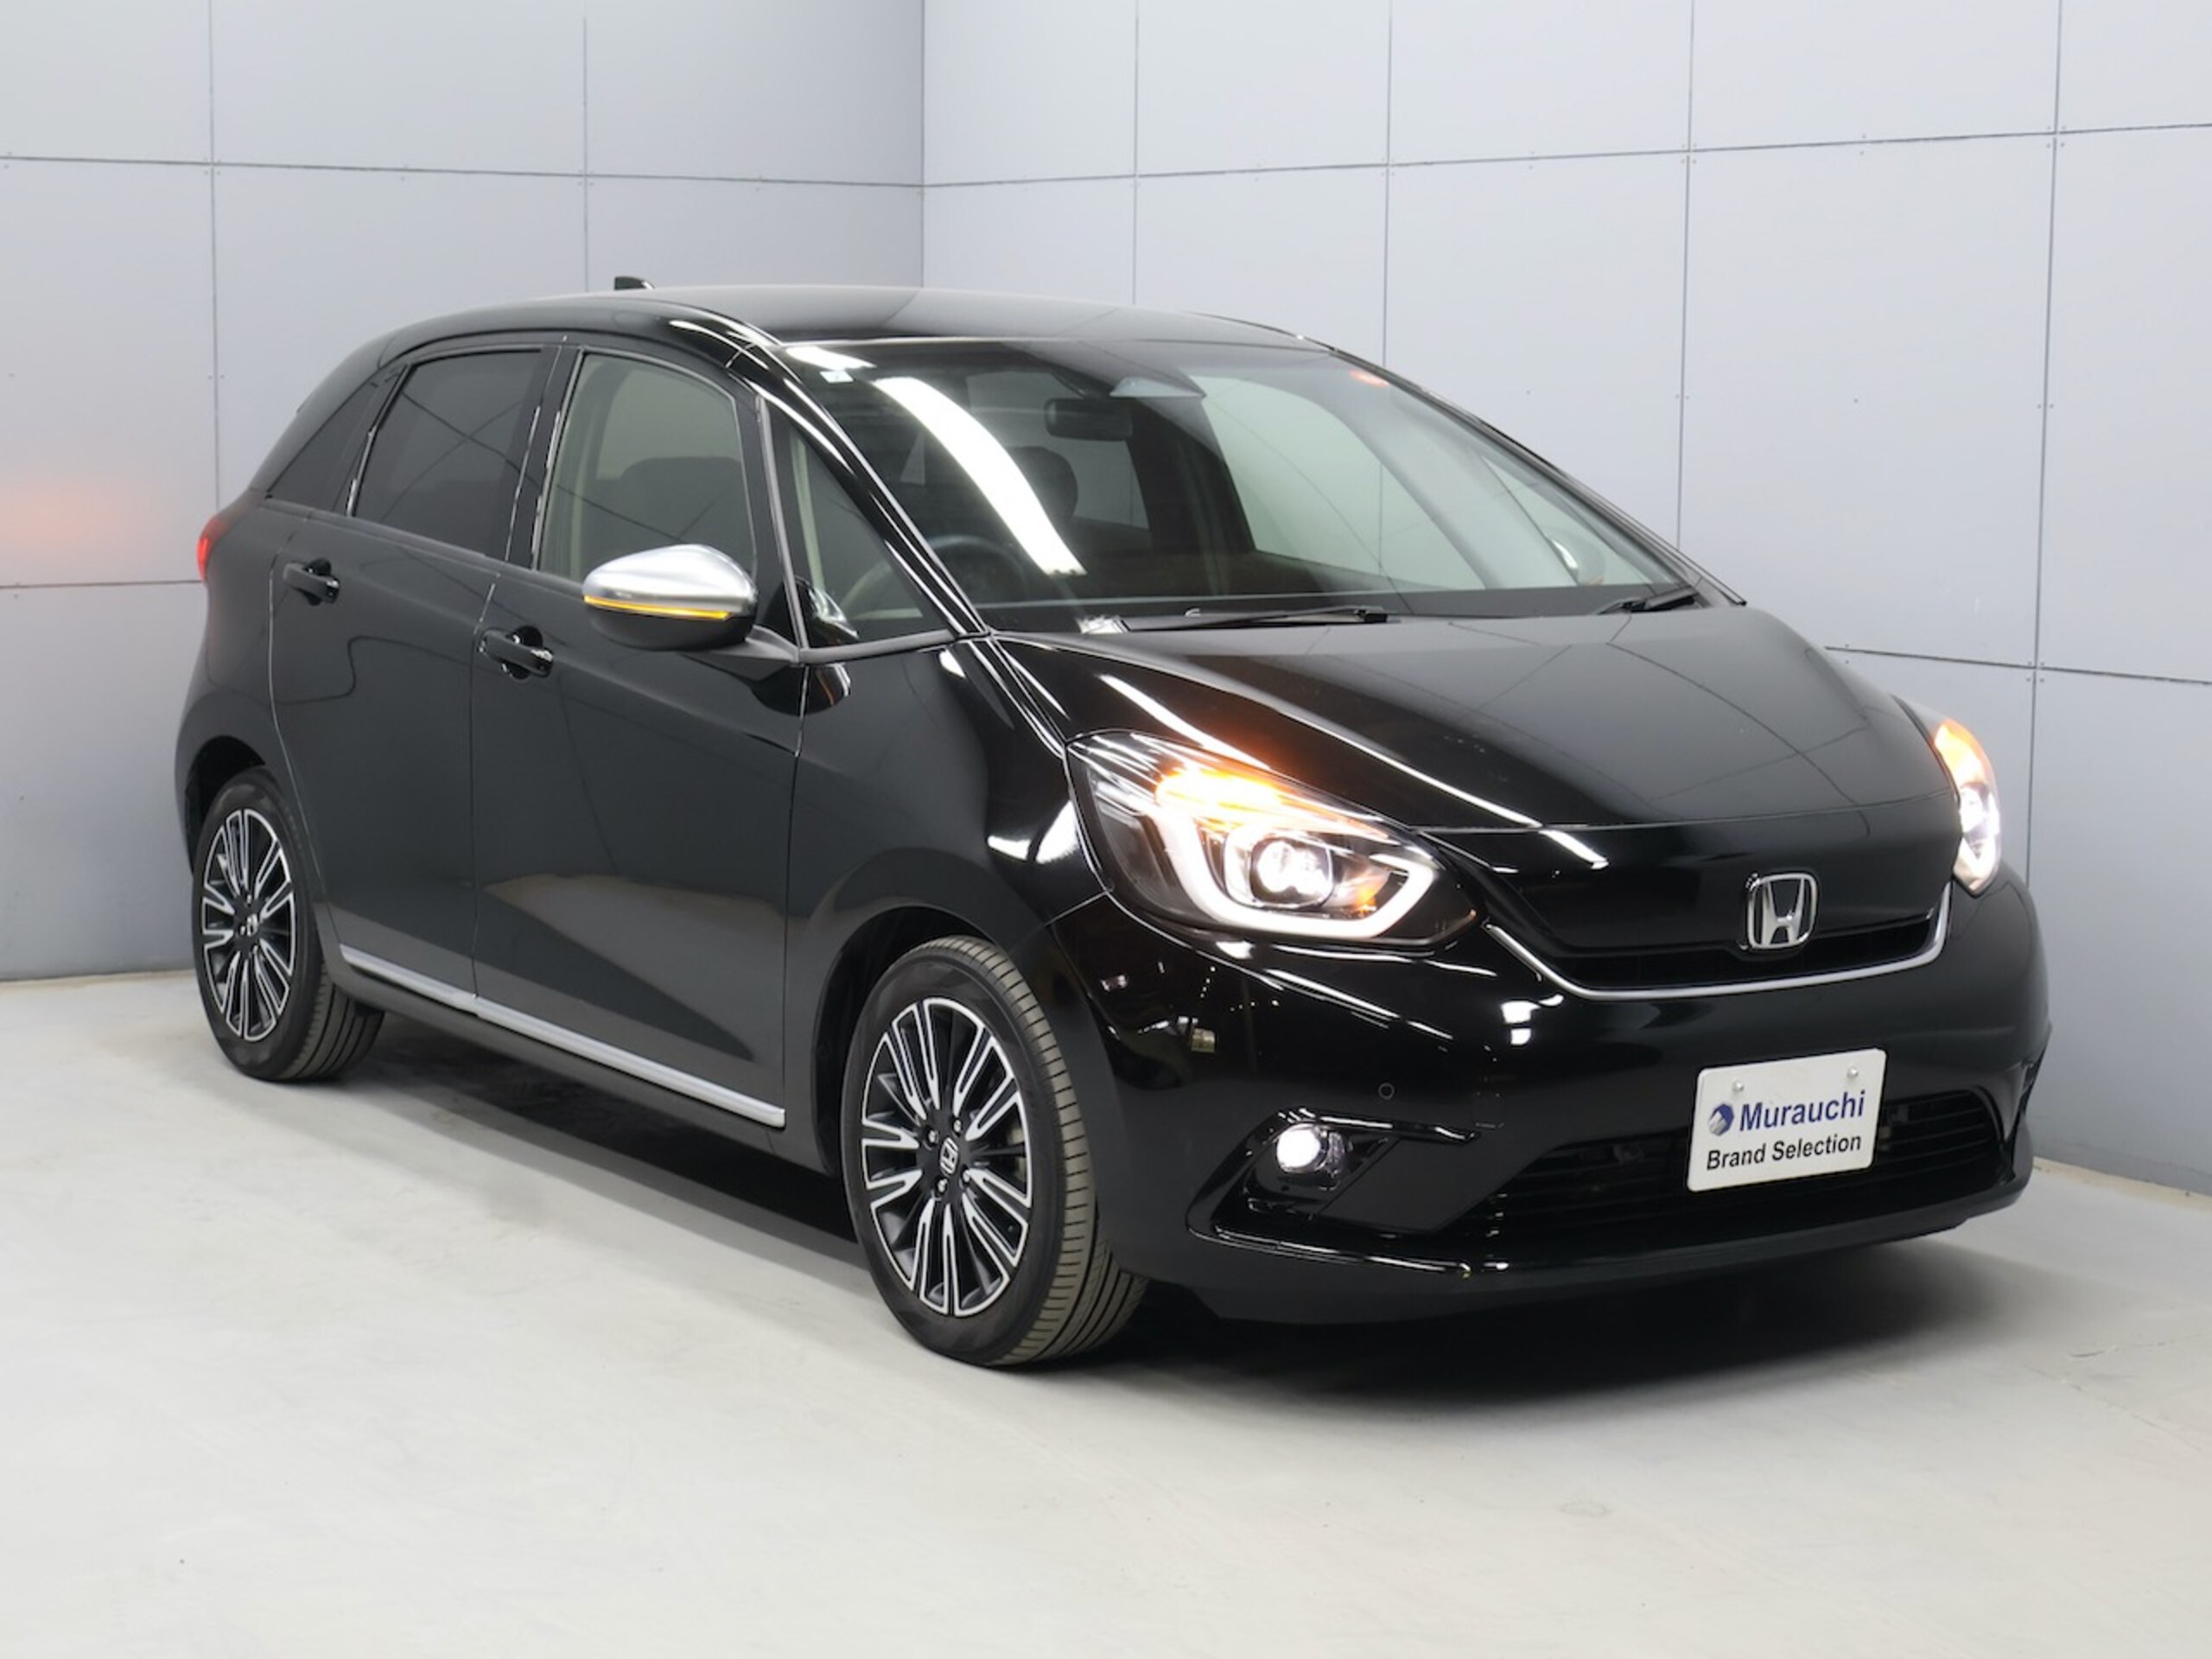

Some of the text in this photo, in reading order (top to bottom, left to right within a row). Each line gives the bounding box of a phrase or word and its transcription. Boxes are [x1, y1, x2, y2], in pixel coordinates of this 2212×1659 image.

[1739, 1090, 1866, 1132] Murauchi
[1707, 1134, 1862, 1171] Brand Selection
